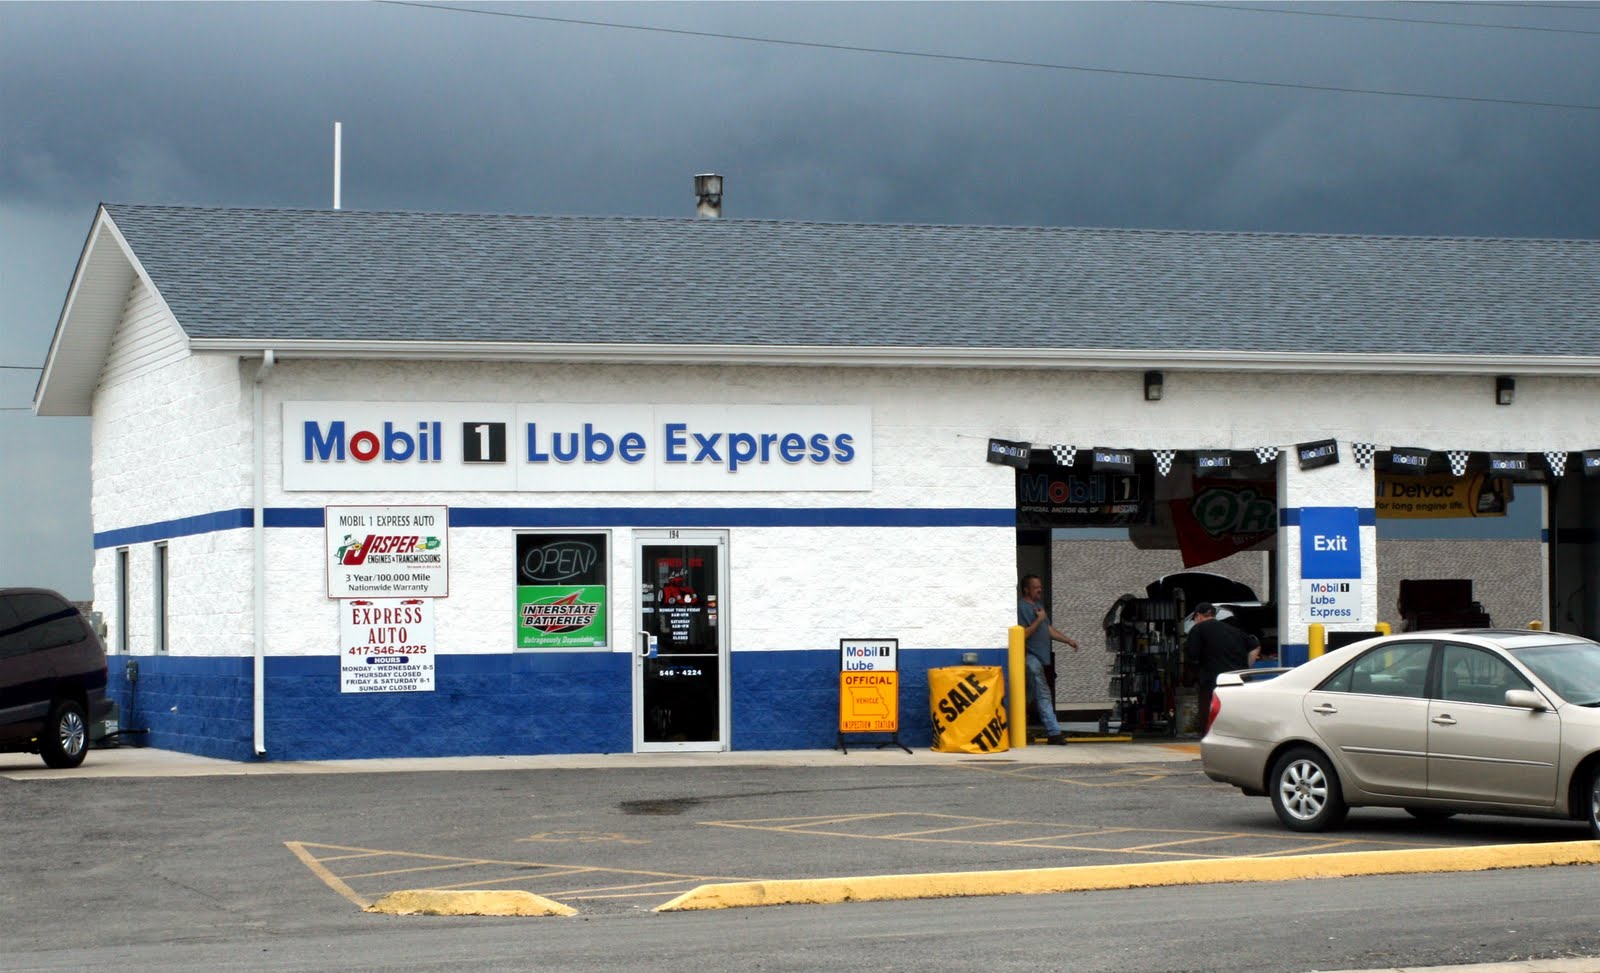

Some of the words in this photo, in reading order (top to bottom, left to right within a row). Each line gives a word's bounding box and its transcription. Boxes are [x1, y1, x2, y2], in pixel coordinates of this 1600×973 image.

[303, 420, 442, 463] Mobil
[527, 422, 647, 463] Lube
[665, 422, 855, 473] Express
[991, 442, 1016, 457] Mobil
[1301, 446, 1326, 460] Mobil
[1096, 453, 1121, 464] Mobil
[1200, 457, 1224, 467] Mobil
[1392, 454, 1417, 465] Mobil
[1586, 457, 1600, 466] Mo
[1493, 460, 1515, 469] Mobil
[1020, 474, 1105, 504] Mobil
[1392, 481, 1454, 498] Delvac
[1392, 502, 1413, 512] long
[1416, 502, 1447, 512] engine
[340, 516, 365, 526] MOBIL
[369, 516, 373, 526] 1
[377, 516, 410, 526] EXPRESS
[413, 516, 434, 526] AUTO
[670, 530, 679, 538] 194
[1314, 535, 1348, 551] Exit
[343, 535, 419, 565] JASPER
[368, 555, 391, 563] ENGINES
[396, 554, 441, 563] TRANSMISSIONS
[526, 548, 591, 573] OPEN
[412, 573, 430, 581] Mile
[393, 584, 428, 592] Warranty
[1311, 583, 1338, 592] Mobil
[1311, 595, 1335, 604] Lube
[523, 605, 596, 614] INTERSTATE
[1311, 607, 1351, 618] Express
[353, 607, 422, 624] EXPRESS
[525, 616, 591, 625] BATTERIES
[368, 627, 407, 644] AUTO
[349, 645, 427, 655] 417-546-4225
[846, 647, 877, 657] Mobil
[846, 661, 874, 670] Lube
[846, 676, 892, 685] OFFICIAL
[938, 673, 989, 722] SALE
[843, 721, 871, 729] INSPECTION
[875, 720, 894, 728] STATION
[970, 708, 1007, 751] TIRE
